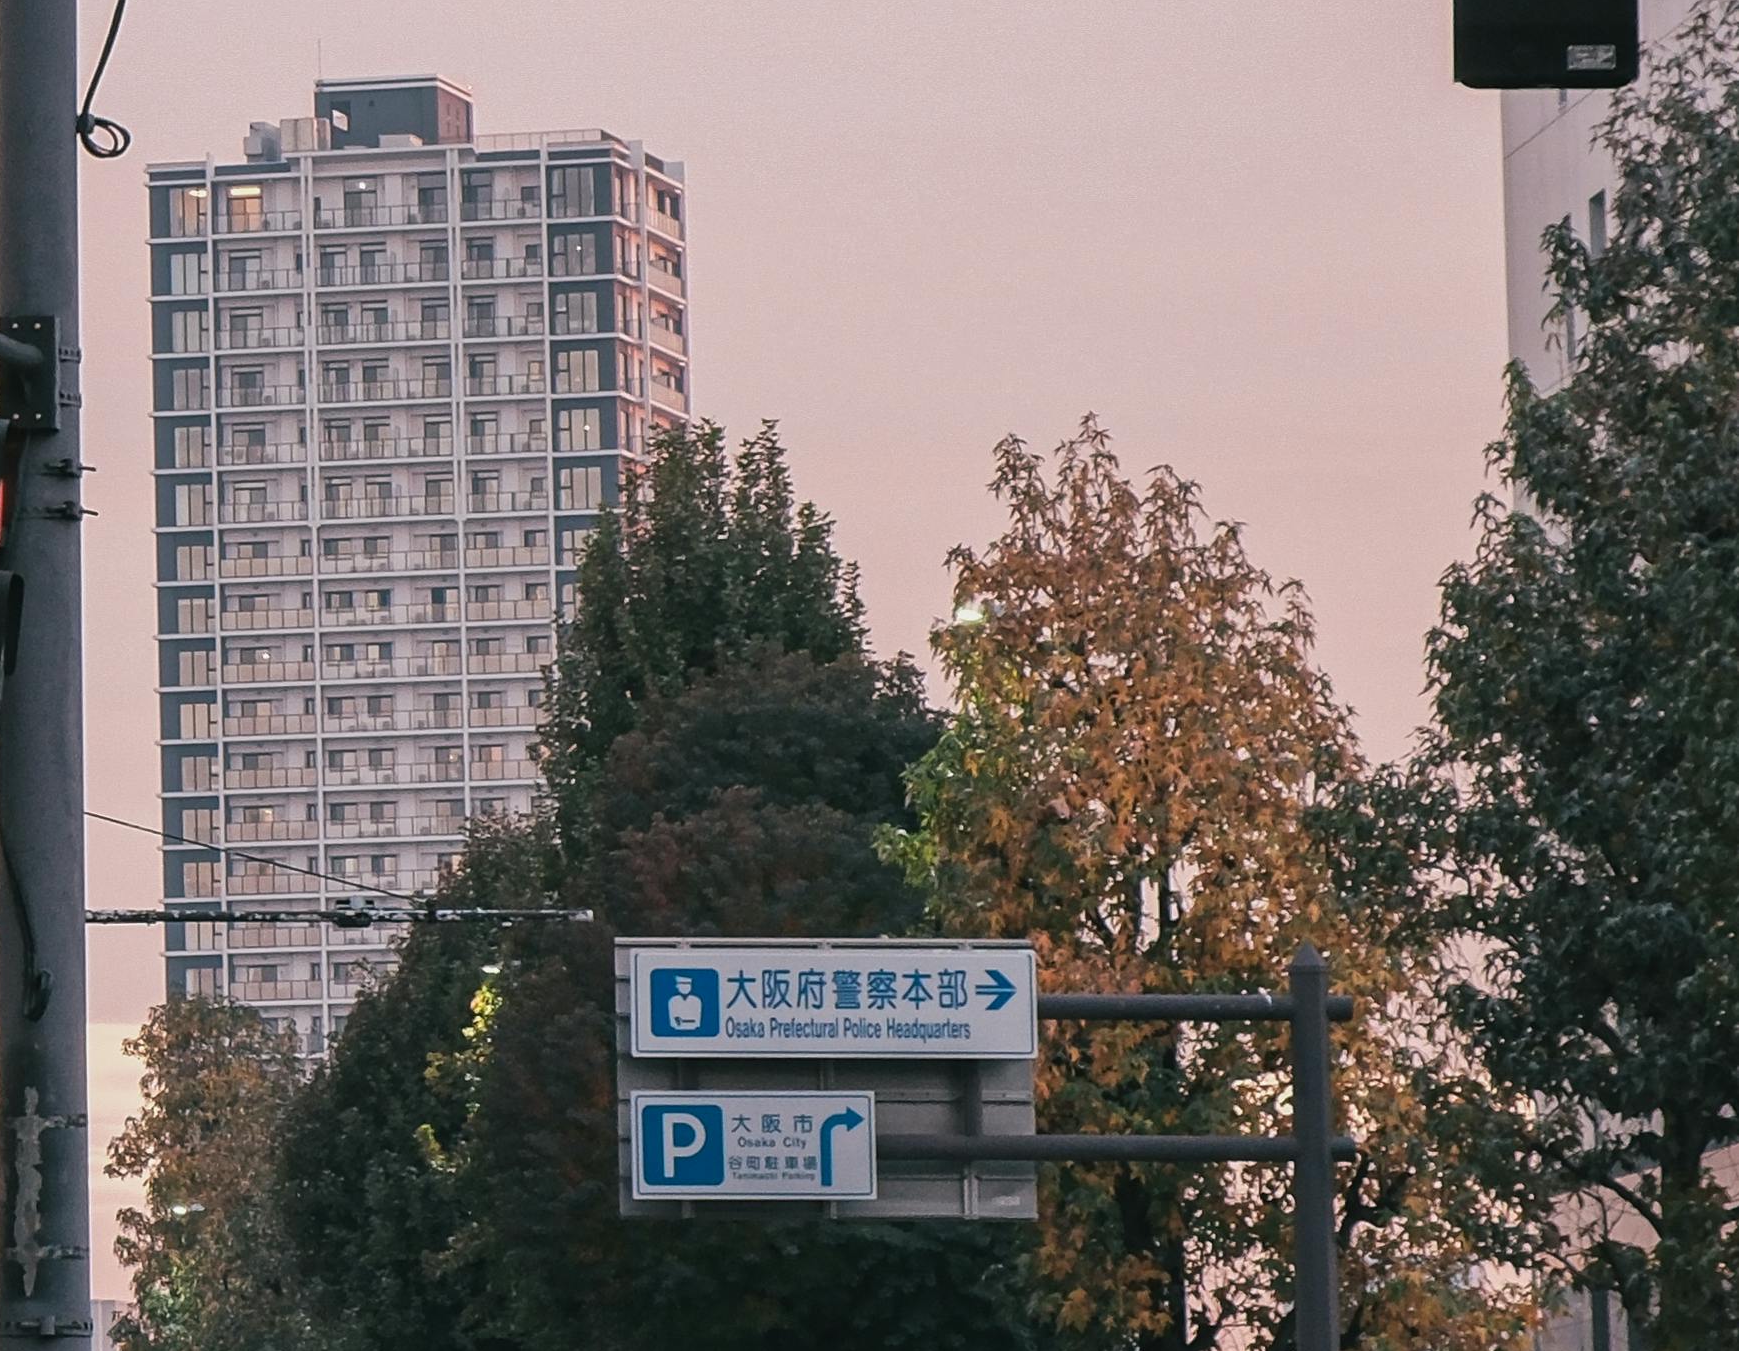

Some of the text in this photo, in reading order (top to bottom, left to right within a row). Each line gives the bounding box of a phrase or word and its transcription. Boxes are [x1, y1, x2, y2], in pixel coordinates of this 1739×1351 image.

[725, 968, 968, 1011] 大阪府警察本部
[725, 1017, 971, 1041] Osaka Prefectural Police Headquarters
[730, 1113, 814, 1134] 大阪市
[662, 1112, 707, 1179] P
[737, 1136, 807, 1150] Osaka City
